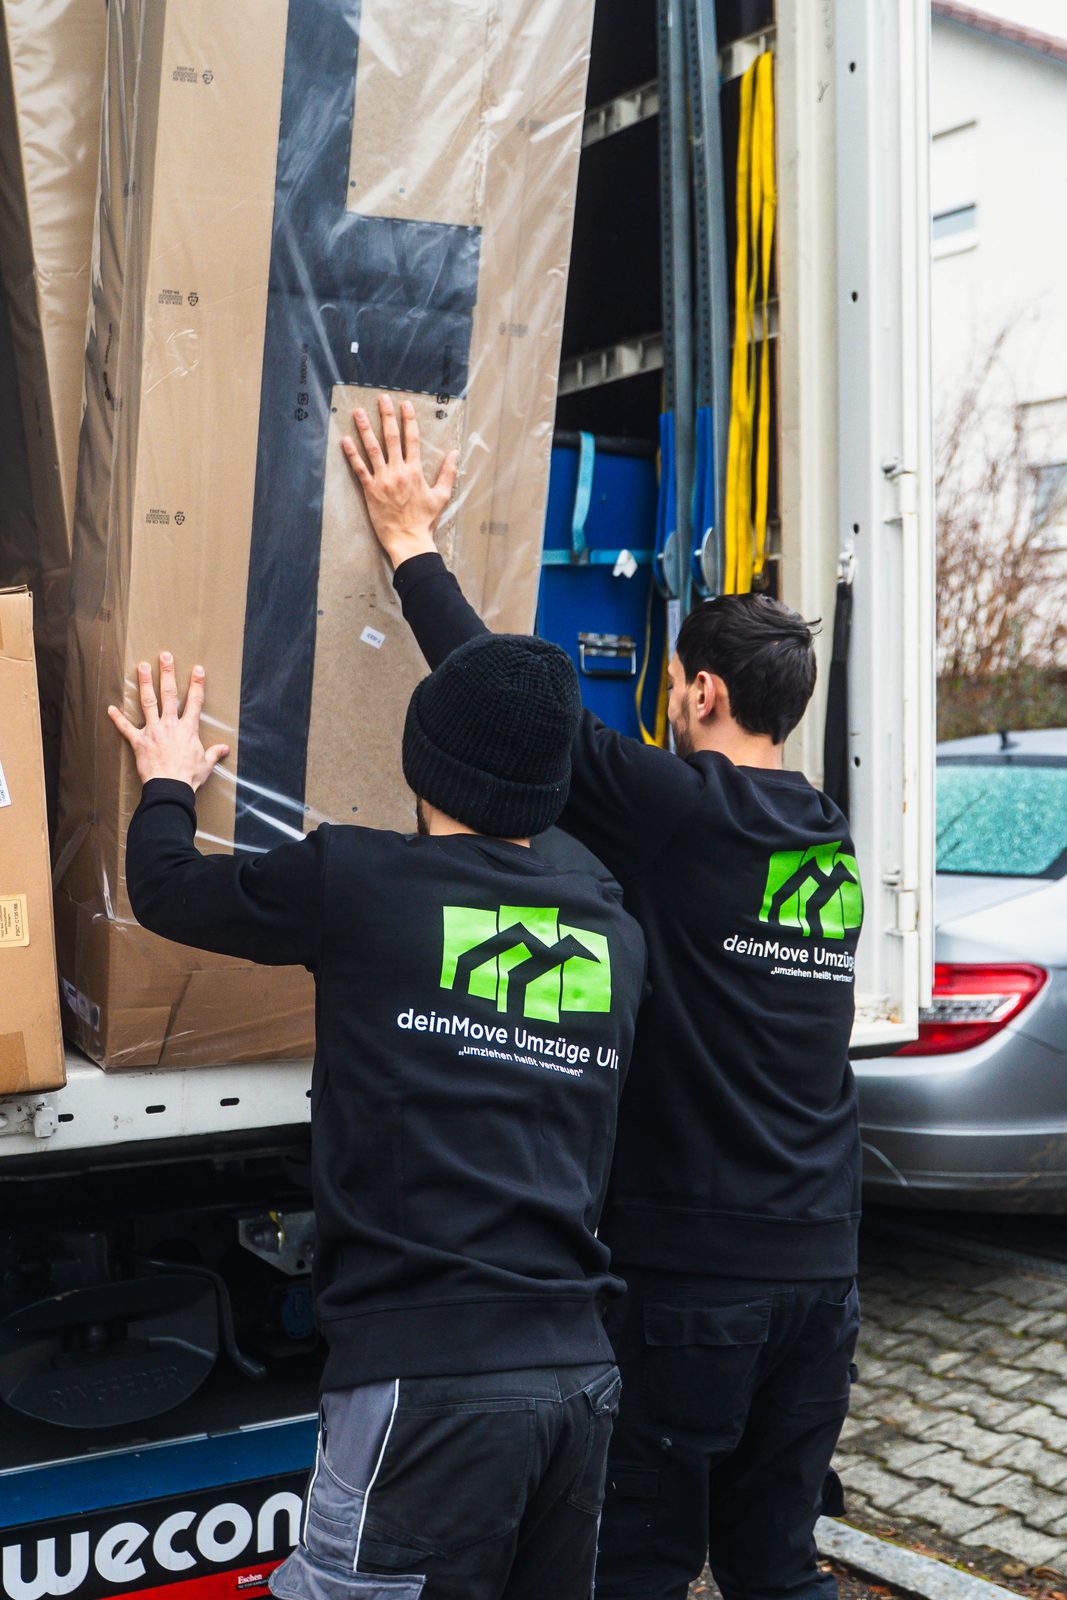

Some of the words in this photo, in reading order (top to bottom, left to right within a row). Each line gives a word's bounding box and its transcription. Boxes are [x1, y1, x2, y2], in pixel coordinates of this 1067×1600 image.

[722, 934, 809, 963] deinMove
[812, 970, 832, 981] heißt
[396, 1008, 508, 1044] deinMove
[514, 1027, 590, 1064] Umzüge
[514, 1052, 539, 1067] heißt
[2, 1491, 303, 1600] wecon
[238, 1573, 263, 1584] Eschen
